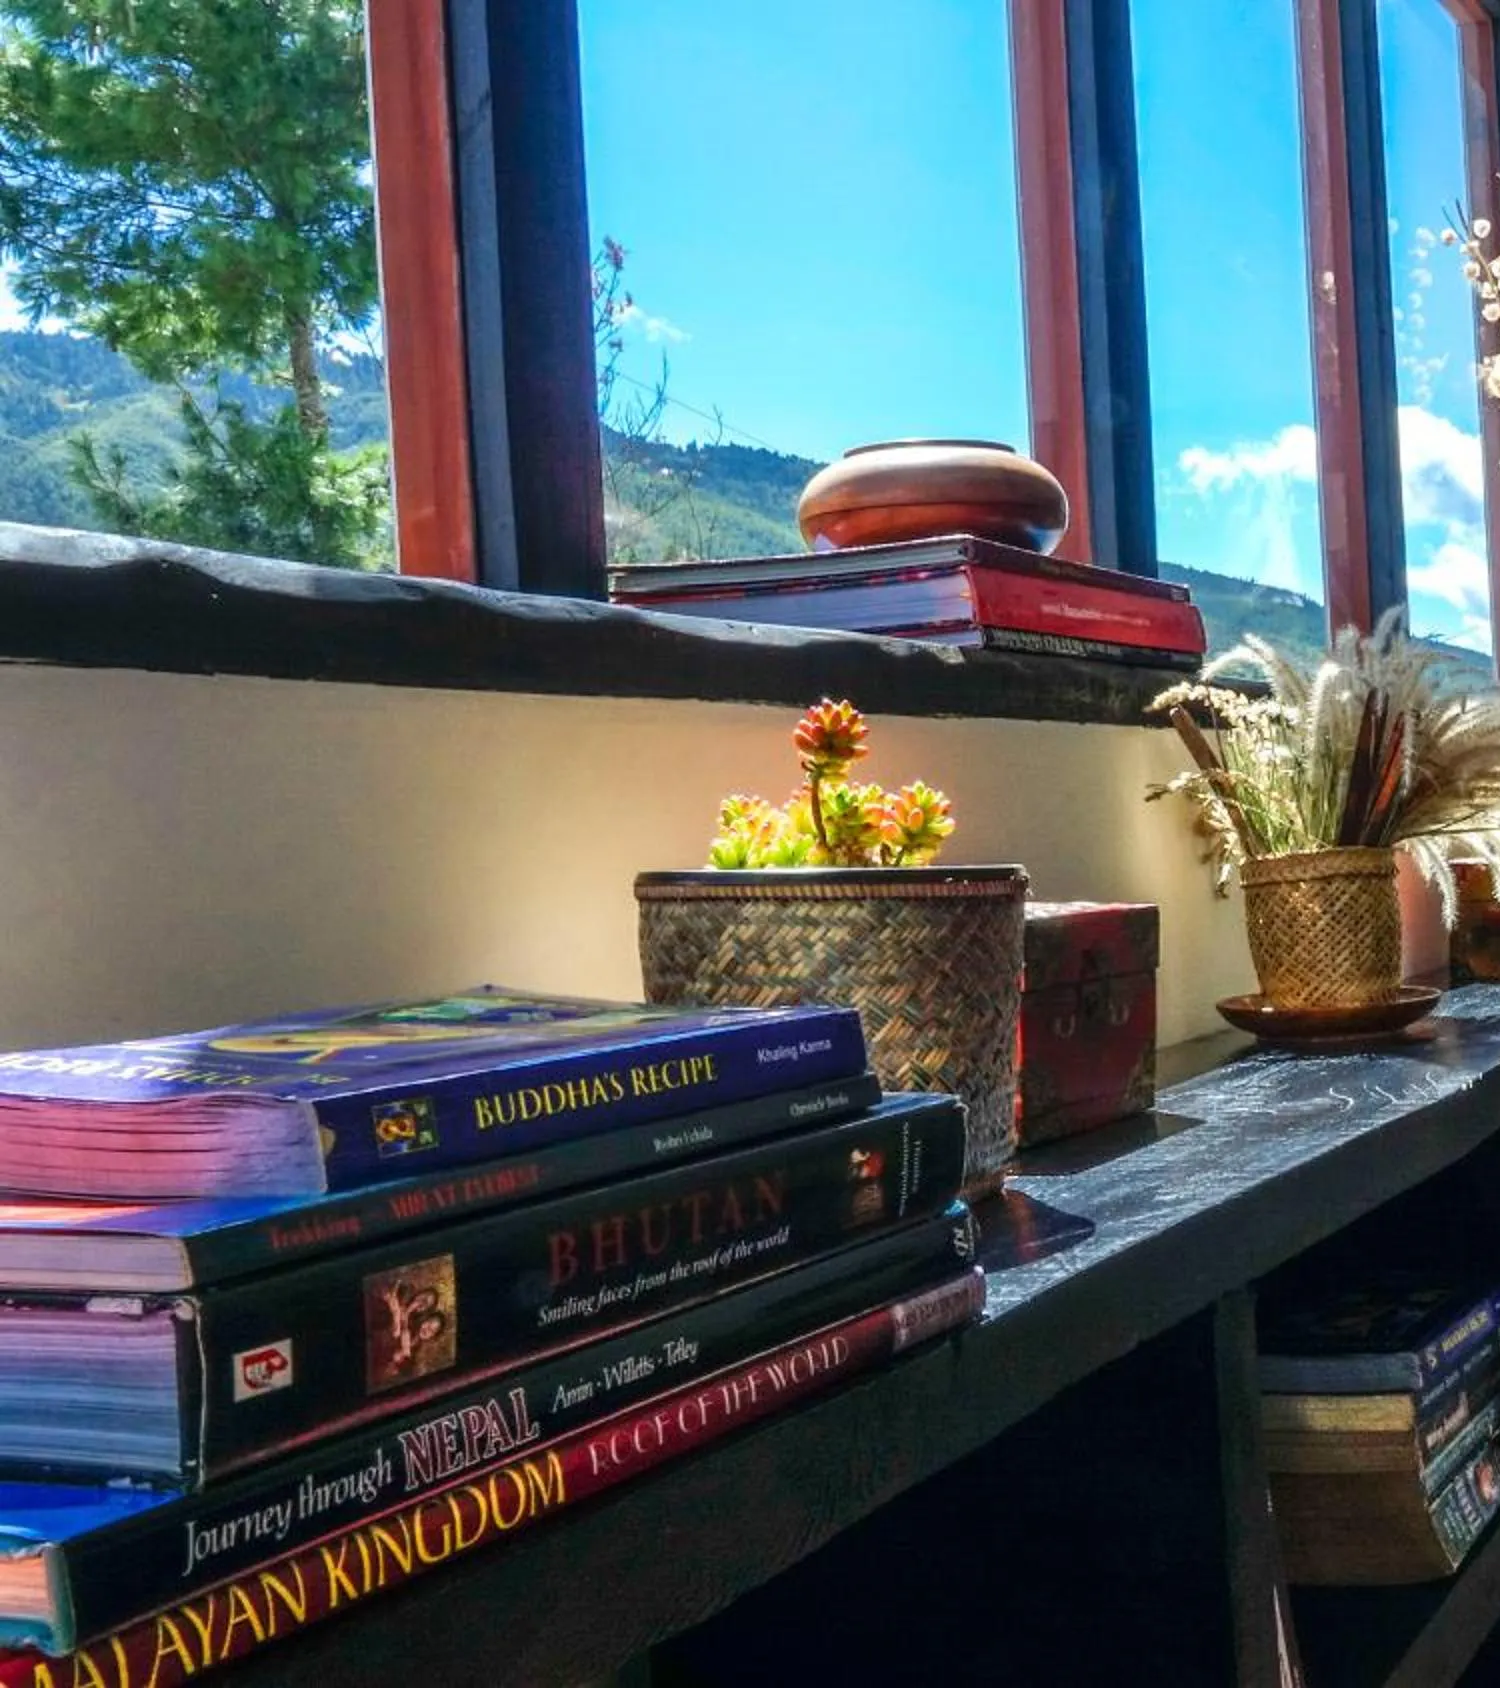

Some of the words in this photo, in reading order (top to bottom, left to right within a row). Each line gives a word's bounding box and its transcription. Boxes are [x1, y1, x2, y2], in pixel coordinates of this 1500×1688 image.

[473, 1071, 625, 1129] BUDDHA'S
[630, 1054, 718, 1097] RECIPE
[757, 1042, 798, 1063] Khaling
[799, 1038, 832, 1055] Karma
[538, 1296, 599, 1327] Smiling
[596, 1283, 633, 1309] faces
[633, 1271, 667, 1299] from
[669, 1260, 691, 1282] the
[692, 1248, 721, 1276] roof
[719, 1247, 734, 1268] of
[734, 1238, 753, 1260] the
[756, 1225, 791, 1252] world
[548, 1168, 789, 1288] BHUTAN
[551, 1377, 594, 1414] Amin
[678, 1393, 716, 1434] OF
[721, 1371, 765, 1415] THE
[765, 1336, 849, 1392] WORLD
[182, 1496, 294, 1577] Journey
[299, 1447, 393, 1519] through
[398, 1387, 540, 1492] NEPAL
[320, 1450, 567, 1609] KINGDOM
